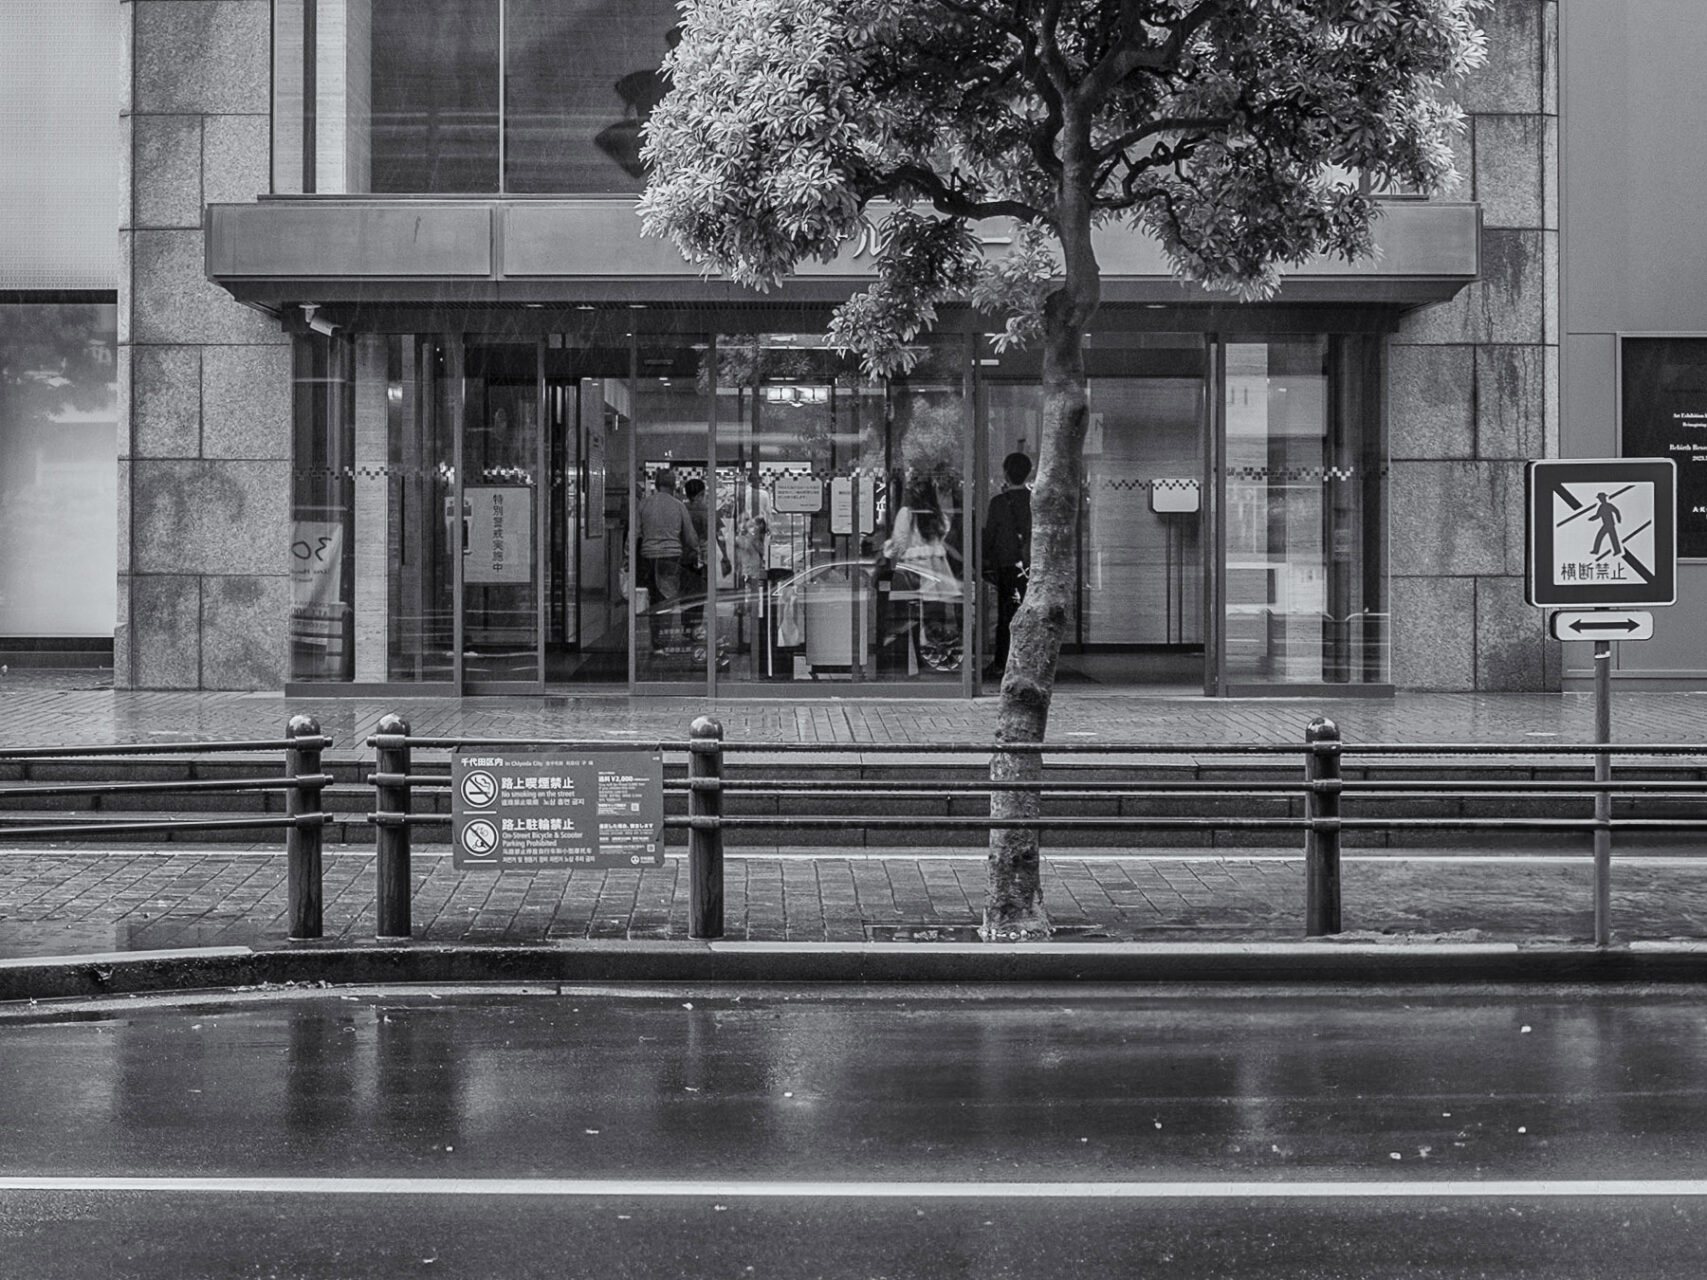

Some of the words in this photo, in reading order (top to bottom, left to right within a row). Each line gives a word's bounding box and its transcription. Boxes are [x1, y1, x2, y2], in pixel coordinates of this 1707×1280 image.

[1560, 562, 1628, 581] 横断禁止
[461, 757, 503, 767] 千代田区内
[502, 777, 575, 789] 路上喫煙禁止
[511, 790, 537, 799] smoking
[502, 818, 575, 831] 路上駐輪禁止
[531, 832, 553, 841] Bicycle
[502, 840, 525, 848] Parking
